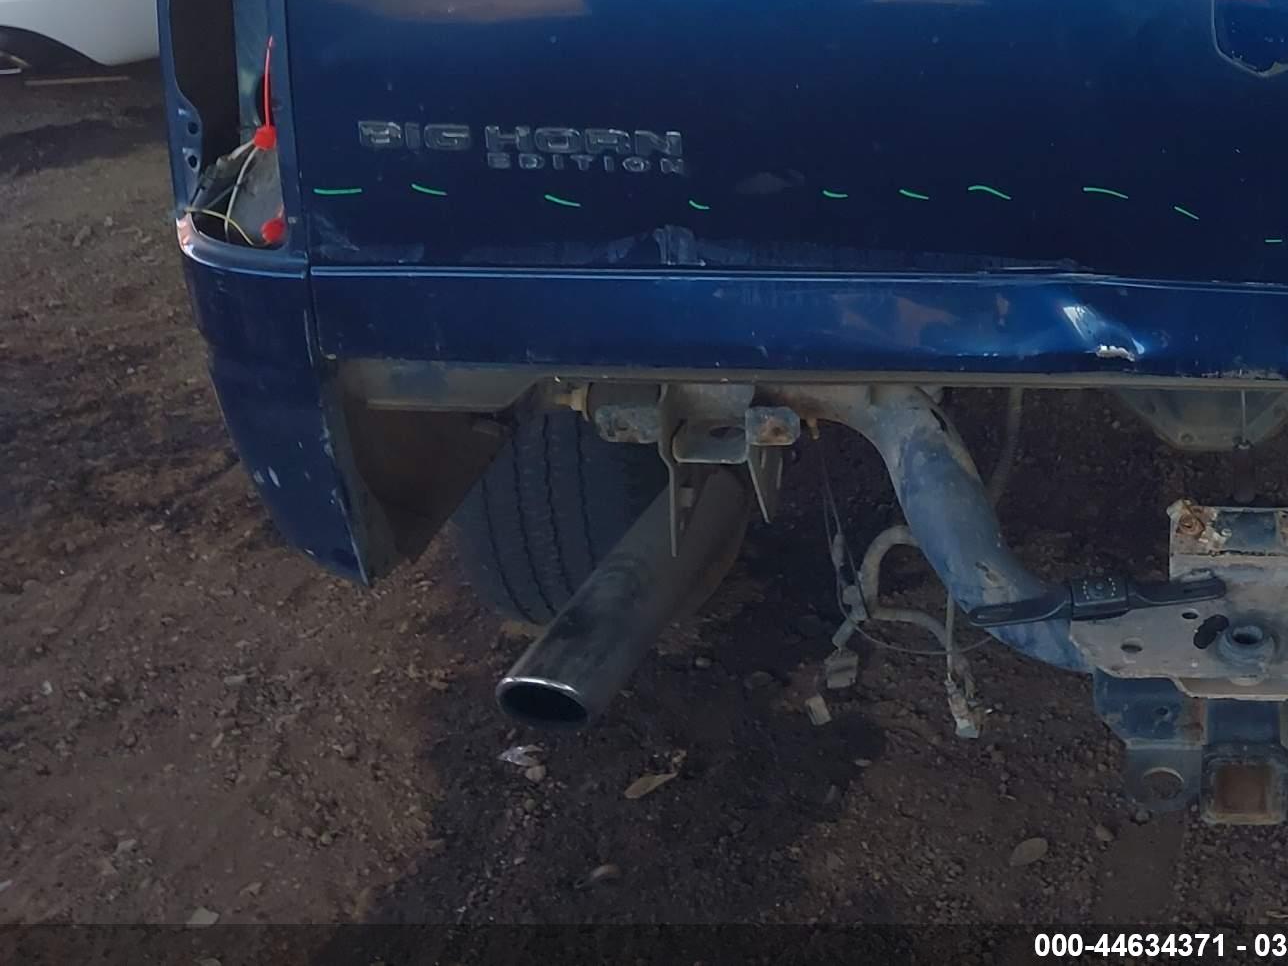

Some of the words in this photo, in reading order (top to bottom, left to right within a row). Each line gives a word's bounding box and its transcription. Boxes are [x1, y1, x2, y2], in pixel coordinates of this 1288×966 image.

[358, 120, 471, 151] BIG
[484, 125, 683, 155] HORN
[486, 153, 685, 173] EDITION
